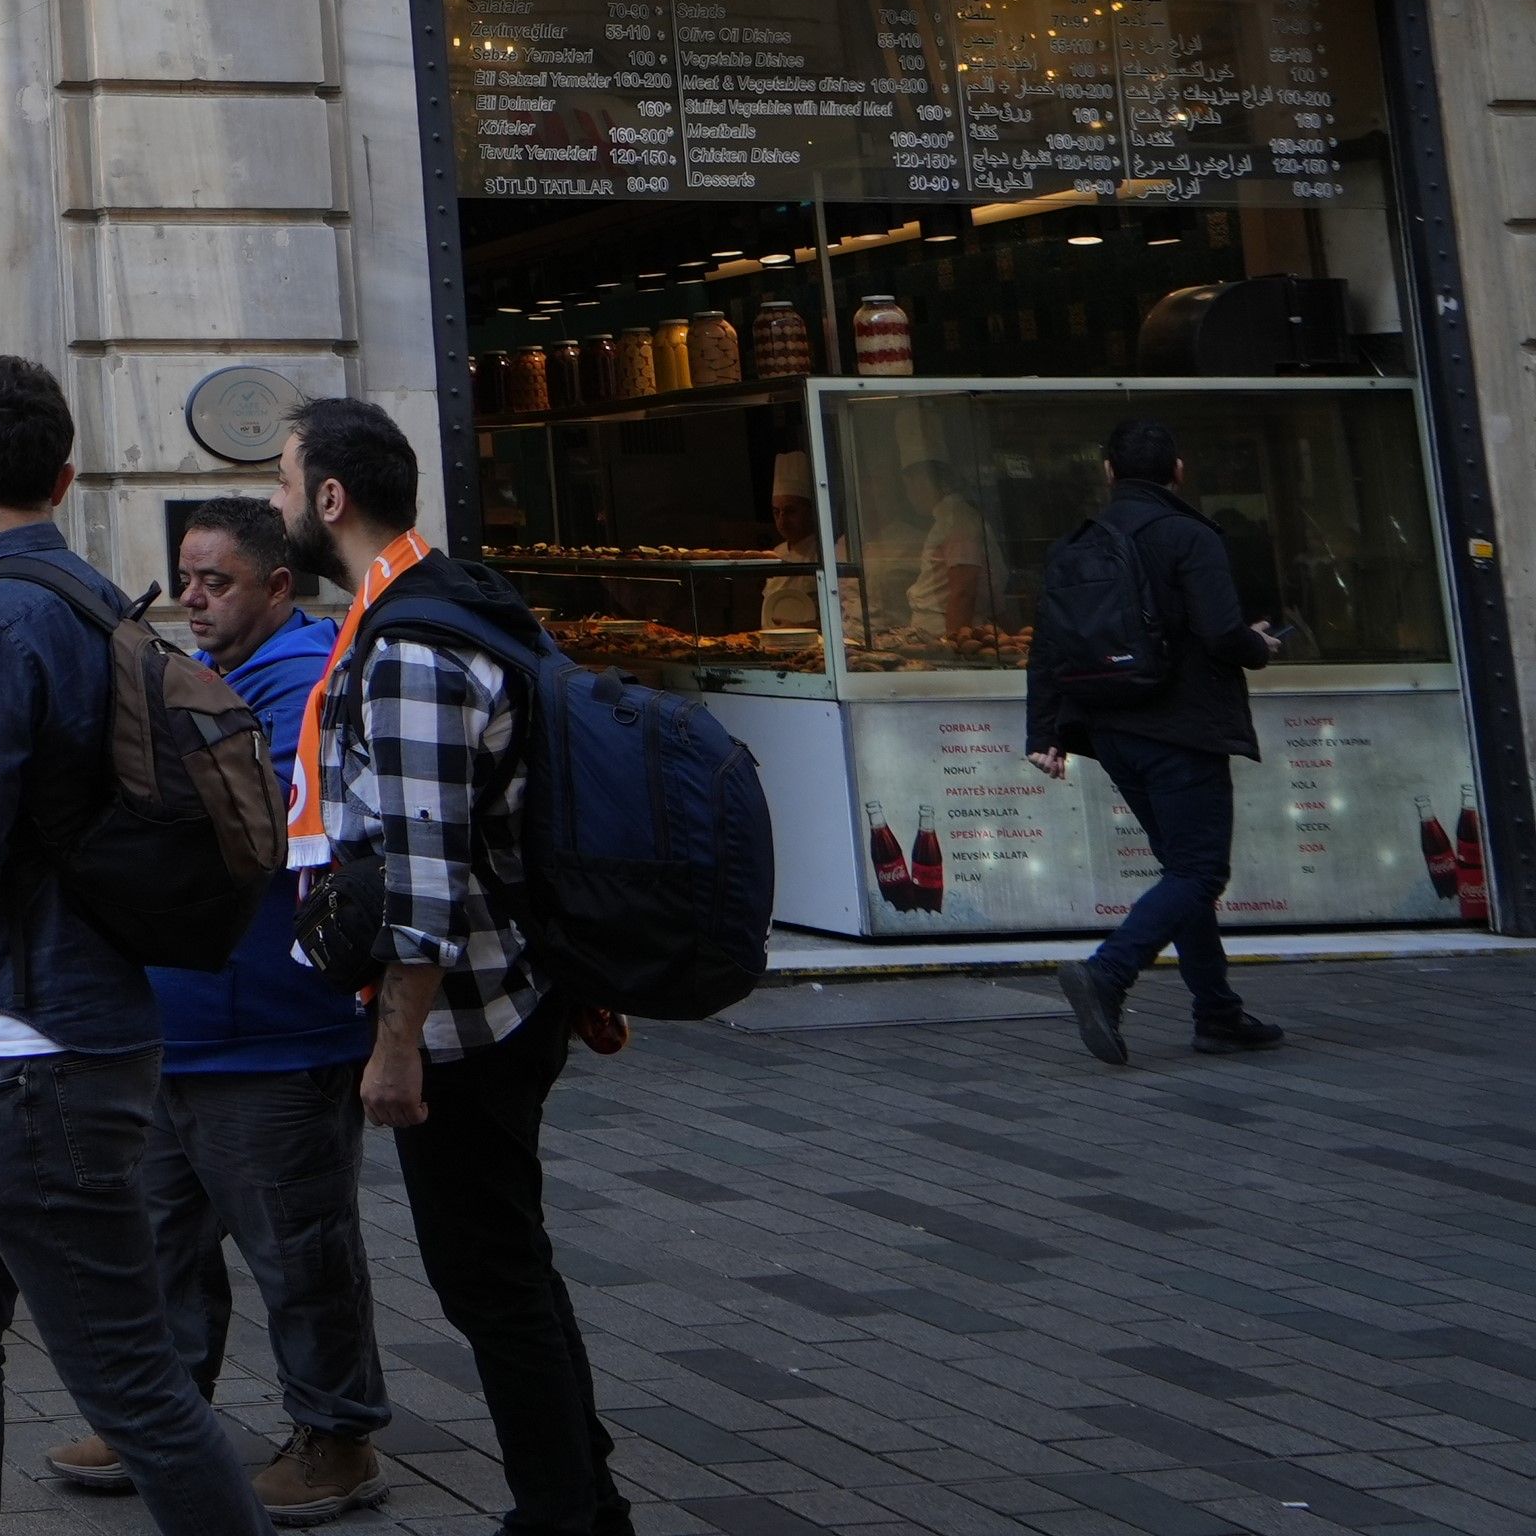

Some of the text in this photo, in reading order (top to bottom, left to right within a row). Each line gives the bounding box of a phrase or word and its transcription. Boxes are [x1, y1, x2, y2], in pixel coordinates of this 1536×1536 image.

[608, 3, 650, 19] 70-90
[676, 3, 726, 19] Salads
[606, 24, 651, 40] 55-110
[679, 27, 921, 48] Olive Oil Dishes 55-110
[523, 47, 594, 64] Yemekleri
[628, 51, 655, 66] 100
[681, 51, 924, 70] Vegetable Dishes 100
[474, 70, 672, 89] Etli Sebzeli Yemekler 160-200
[683, 75, 927, 93] Meat & Vegetables dishes 160-200
[1057, 84, 1114, 99] 160-200
[476, 95, 665, 117] Etli Dolmalar 160
[685, 100, 943, 120] Stuffed Vegetables with Minced Meat 160
[1073, 108, 1099, 123] 160
[478, 119, 668, 144] Köfteler 160-300
[687, 123, 948, 148] Meatballs 160-300
[1046, 134, 1105, 151] 160-300
[479, 144, 668, 165] Tavuk Yemekleri 120-150
[689, 147, 949, 169] Chicken Dishes 120-150
[1055, 154, 1113, 170] 120-150
[485, 176, 669, 195] SÜTLÜ TATLILAR 80-90
[692, 171, 756, 187] Desserts
[939, 723, 991, 734] ÇORBALAR
[941, 745, 1011, 754] KURU FASULYE
[944, 766, 977, 775] NOHUT
[988, 786, 1046, 795] KIZARTMASI
[1291, 781, 1317, 790] KOLA
[948, 808, 1019, 818] ÇOBAN SALATA
[950, 827, 1043, 838] SPESİYAL PİLAVLAR
[953, 850, 1028, 861] MEVSİM SALATA
[1299, 843, 1326, 852] SODA
[955, 870, 982, 882] PİLAV
[1302, 865, 1316, 874] SU
[1226, 898, 1288, 912] tamamla!
